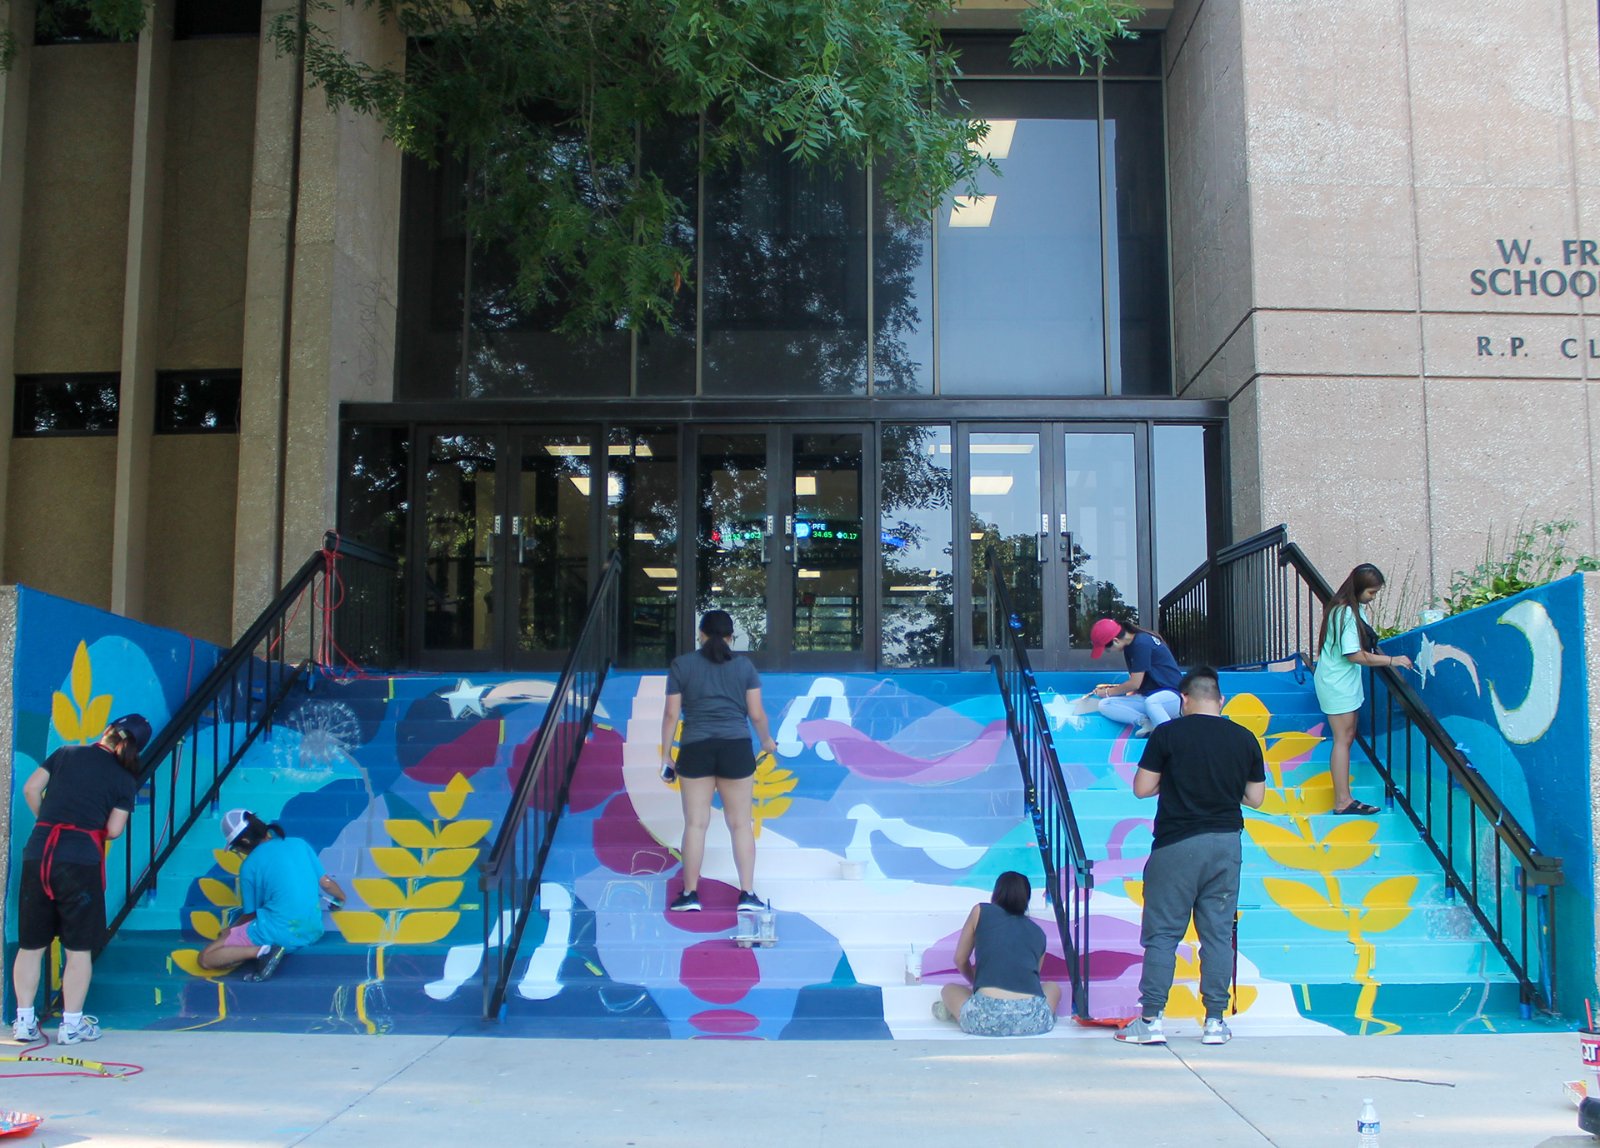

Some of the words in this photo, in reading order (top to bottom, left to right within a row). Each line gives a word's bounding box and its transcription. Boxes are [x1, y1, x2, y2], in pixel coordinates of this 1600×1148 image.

[1496, 239, 1542, 265] W.
[1562, 239, 1600, 265] FR
[1470, 268, 1600, 297] SCHOO
[1477, 336, 1528, 357] R.P.
[1581, 1042, 1599, 1062] QT
